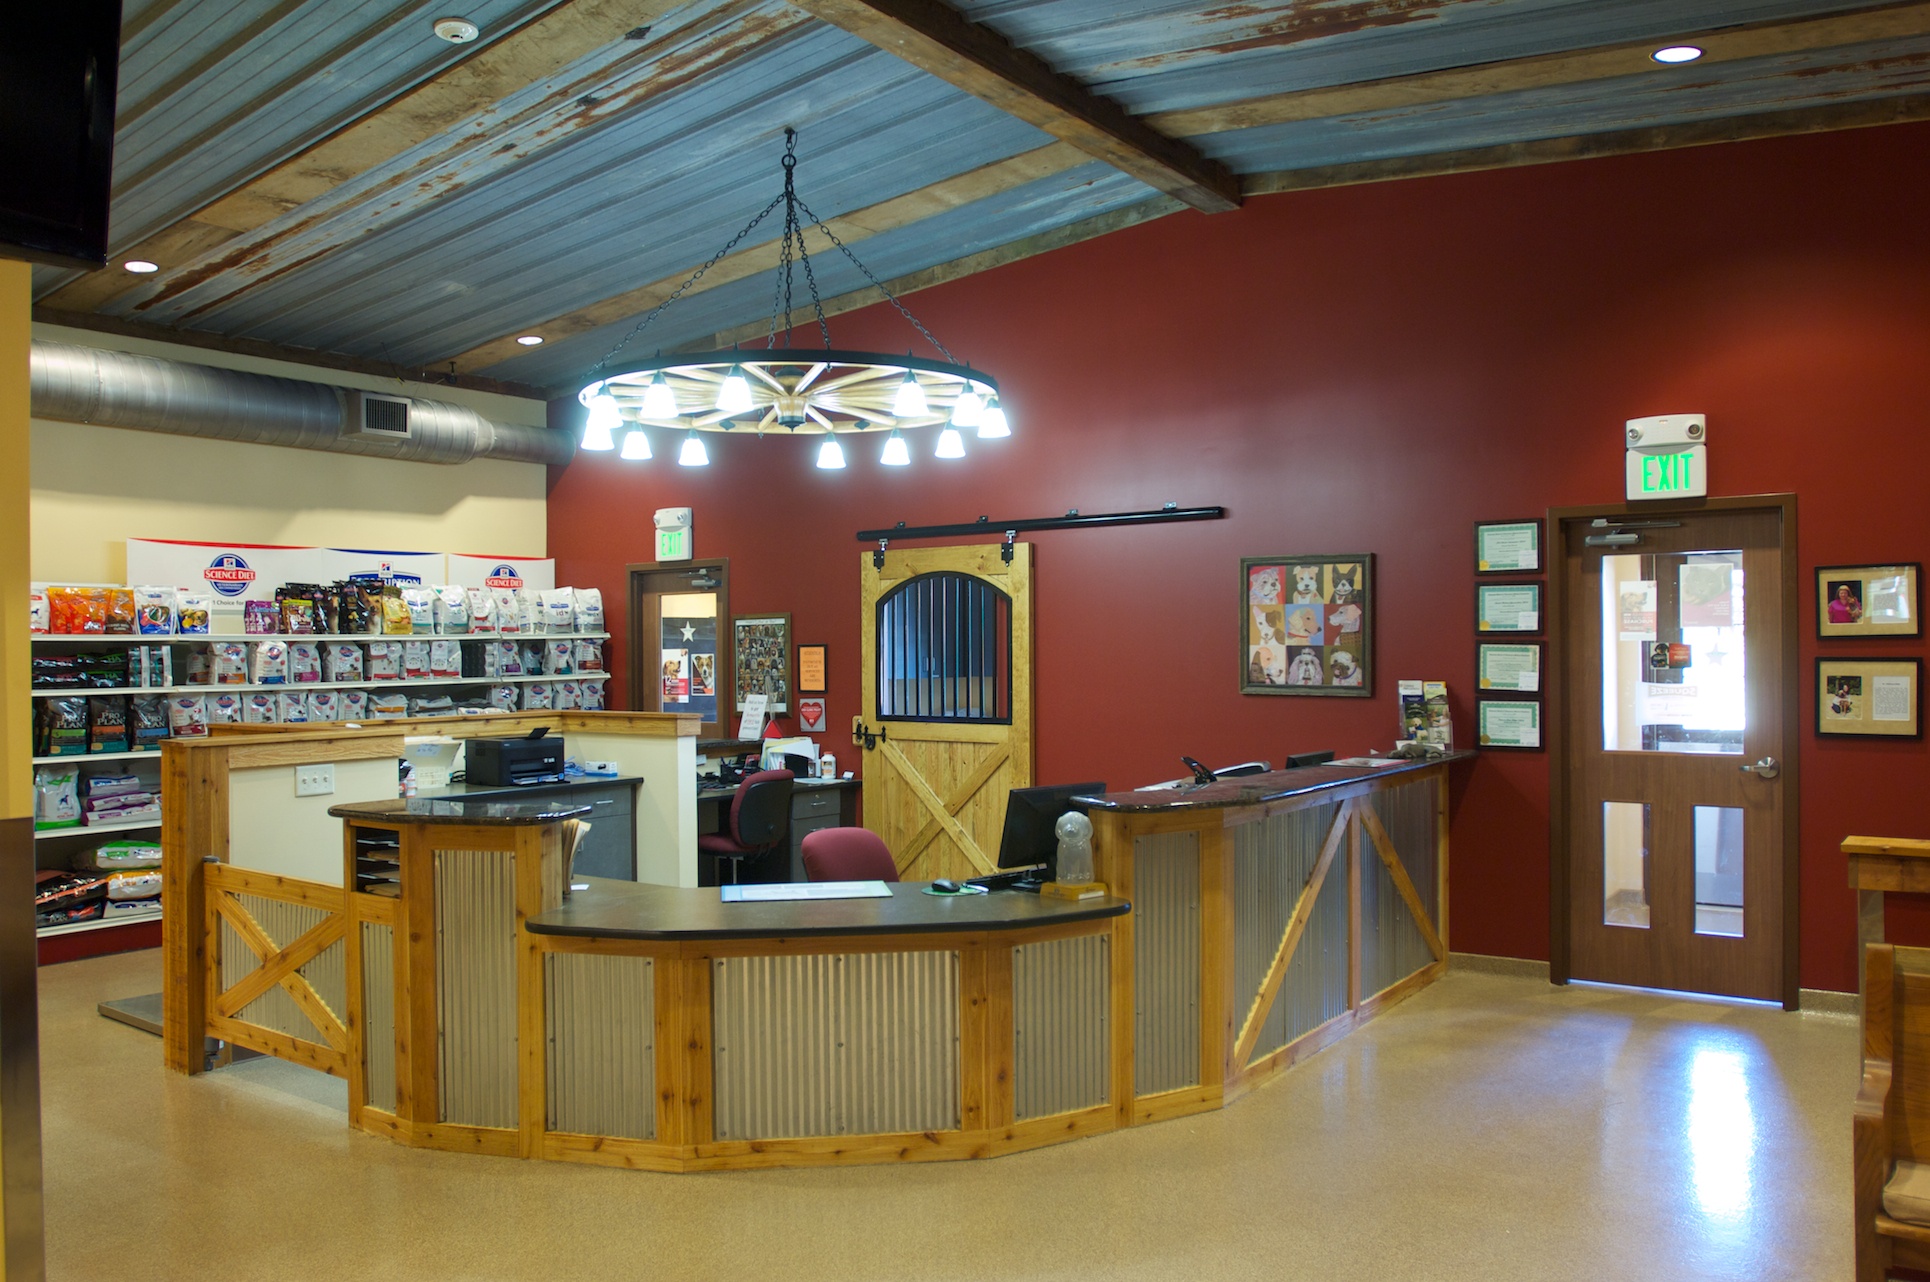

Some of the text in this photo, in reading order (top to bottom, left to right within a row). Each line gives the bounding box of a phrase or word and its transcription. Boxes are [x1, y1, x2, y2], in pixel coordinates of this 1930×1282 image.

[1642, 453, 1694, 492] EXIT
[661, 532, 683, 557] EXIT
[205, 570, 255, 581] SCIENCE DIET
[486, 579, 522, 588] SCIENCE DIET
[97, 718, 125, 726] PLAN
